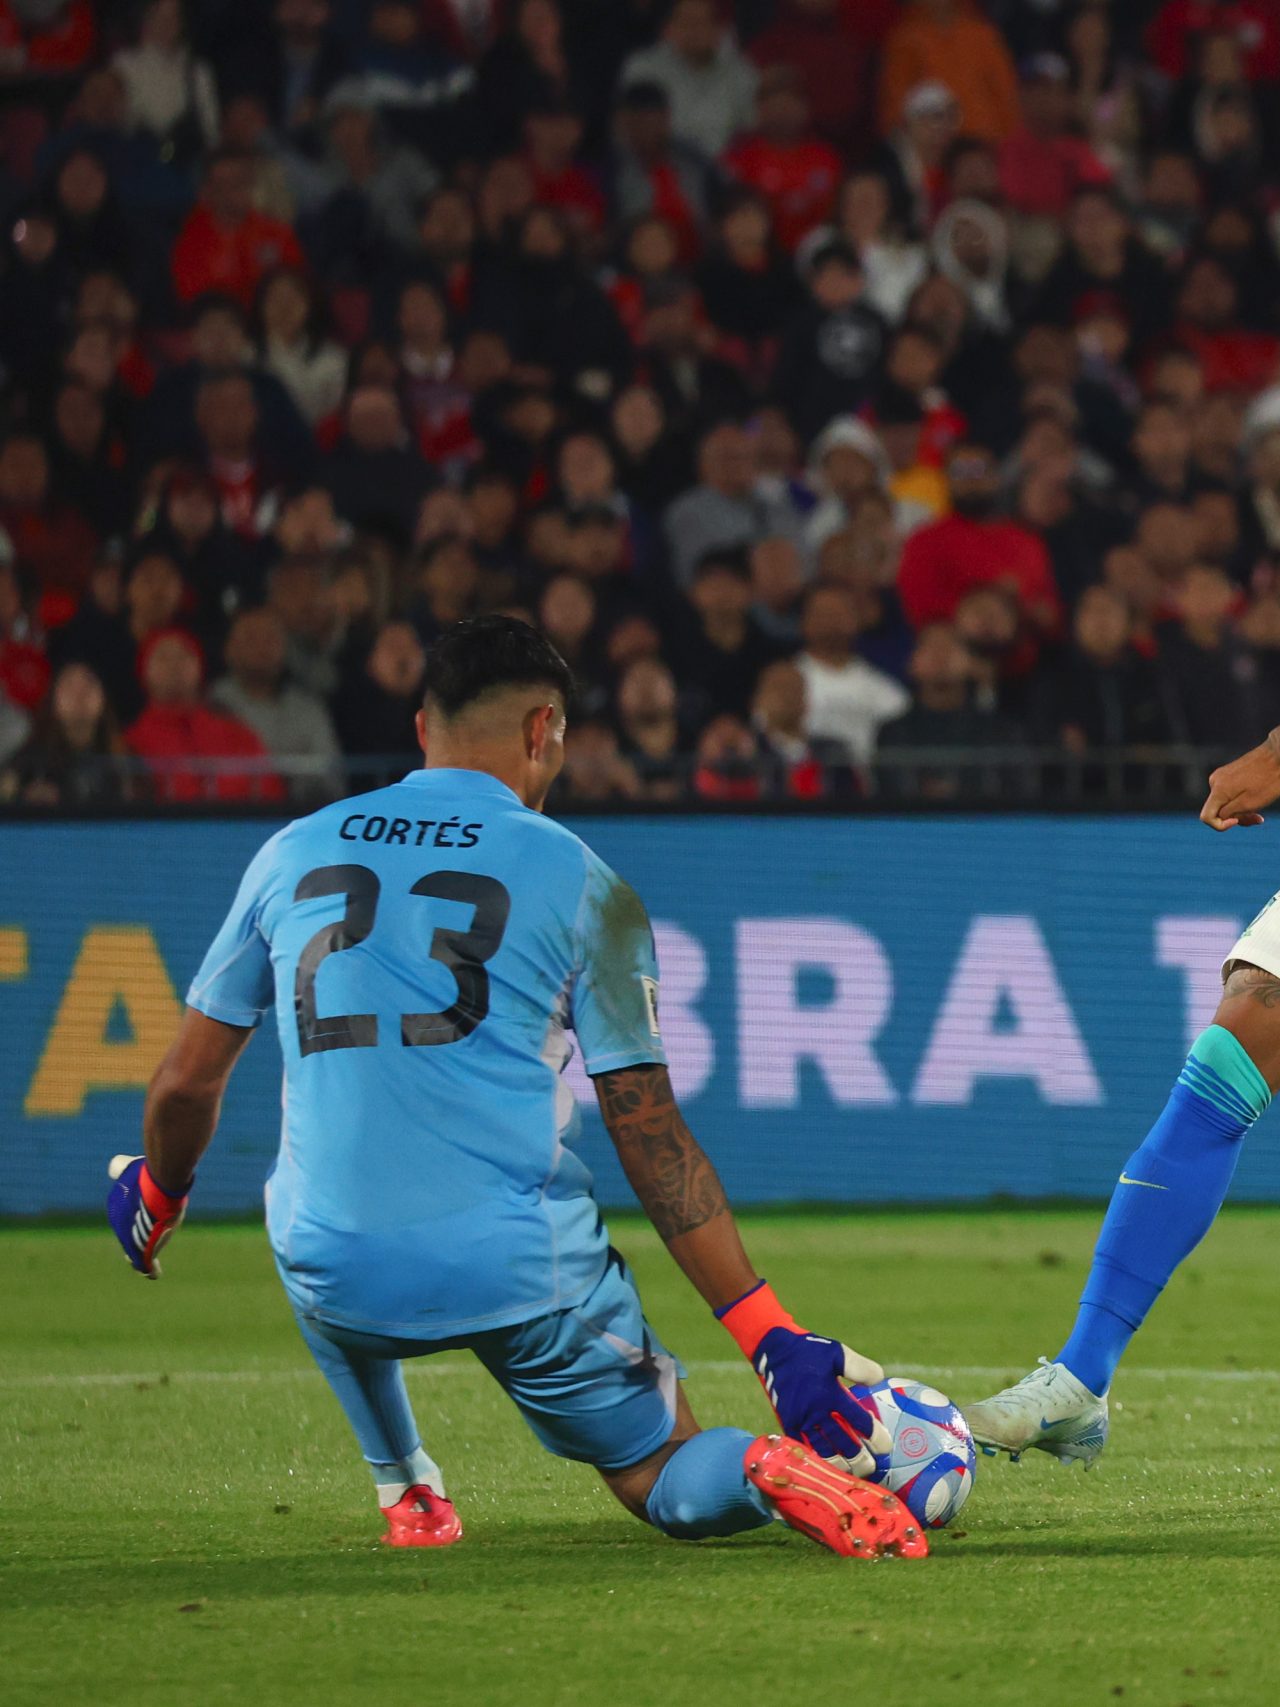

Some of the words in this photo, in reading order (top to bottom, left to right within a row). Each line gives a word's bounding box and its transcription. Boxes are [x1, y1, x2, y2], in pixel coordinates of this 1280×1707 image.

[339, 814, 484, 848] CORTÉS
[0, 922, 188, 1117] A
[294, 863, 512, 1058] 23
